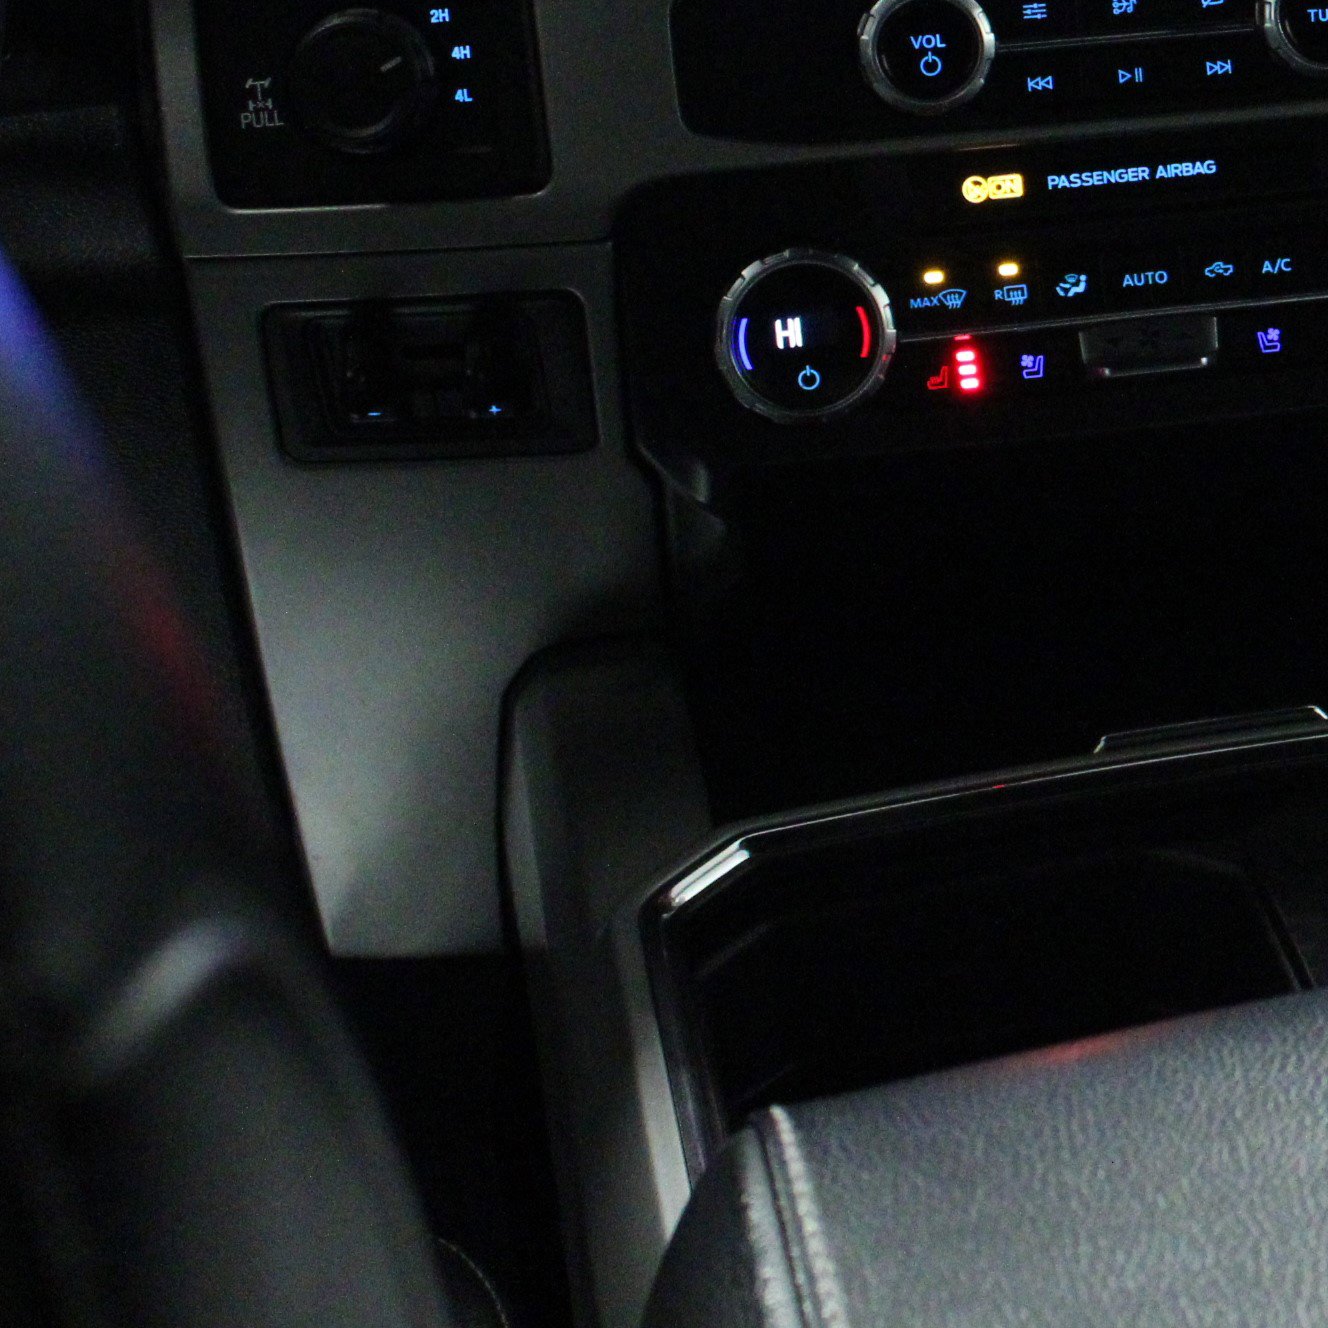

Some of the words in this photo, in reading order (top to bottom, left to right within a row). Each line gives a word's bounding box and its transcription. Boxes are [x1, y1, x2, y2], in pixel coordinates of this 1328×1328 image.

[430, 8, 450, 24] 2H
[910, 33, 947, 50] VOL
[451, 44, 471, 60] 4H
[454, 88, 473, 103] 4L
[241, 110, 285, 129] PULL
[1047, 166, 1150, 190] PASSENGER
[1155, 160, 1217, 180] AIRBAG
[1262, 258, 1292, 274] A/C
[1122, 271, 1168, 287] AUTO
[910, 296, 938, 310] MAX
[995, 289, 1003, 301] R
[775, 317, 802, 349] HI
